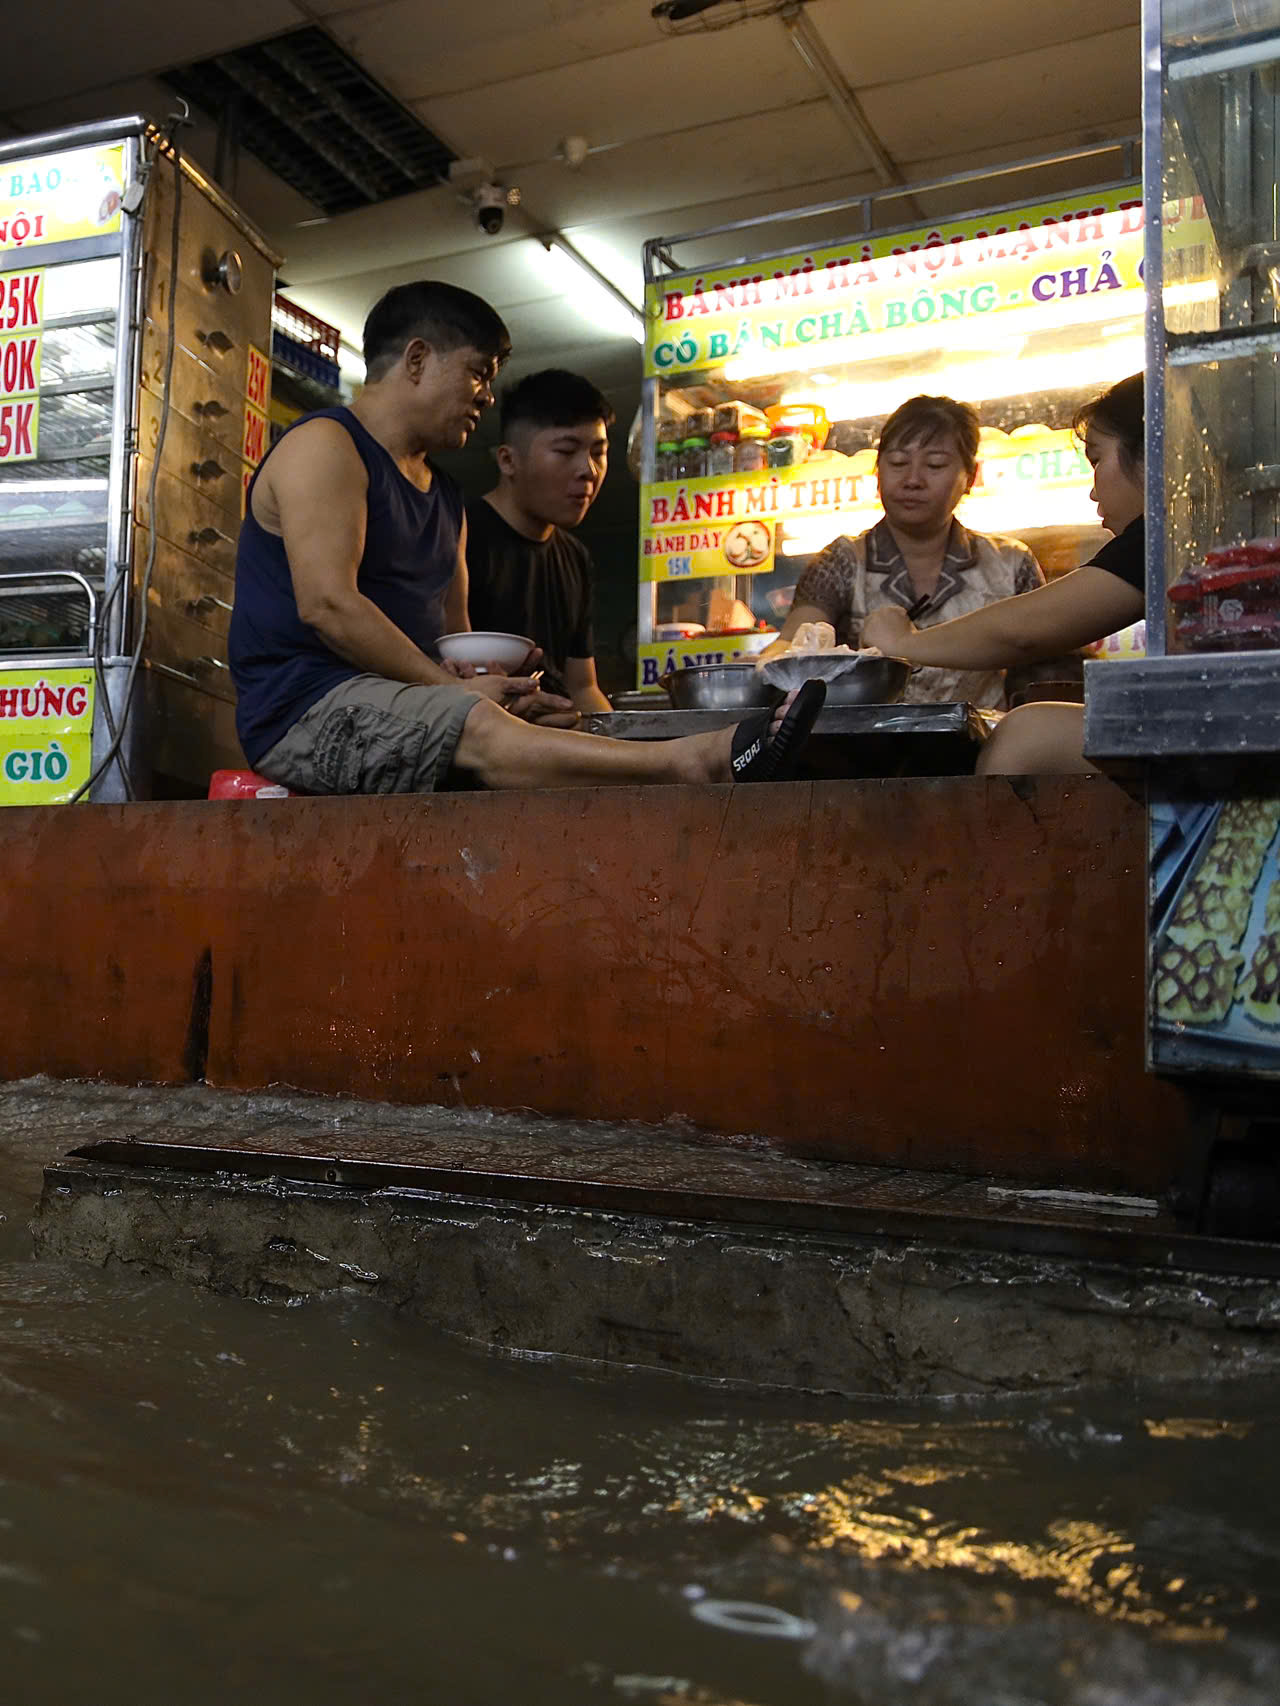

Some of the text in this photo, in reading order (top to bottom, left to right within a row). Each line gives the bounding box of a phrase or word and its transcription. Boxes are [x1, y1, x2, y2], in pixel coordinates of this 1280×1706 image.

[10, 168, 61, 197] BAO
[665, 275, 763, 321] BÁNH
[773, 257, 815, 300] MÌ
[826, 244, 878, 290] HÀ
[891, 231, 965, 279] NỘI
[976, 207, 1105, 262] MẠNH
[653, 331, 697, 368] CÓ
[886, 285, 997, 329] BÔNG
[1032, 250, 1122, 302] CHẢ
[650, 488, 736, 524] BÁNH
[745, 476, 778, 514] MÌ
[790, 475, 862, 511] THỊT
[643, 532, 685, 556] BÁNH
[667, 556, 692, 576] 15K
[5, 743, 68, 781] GIÒ
